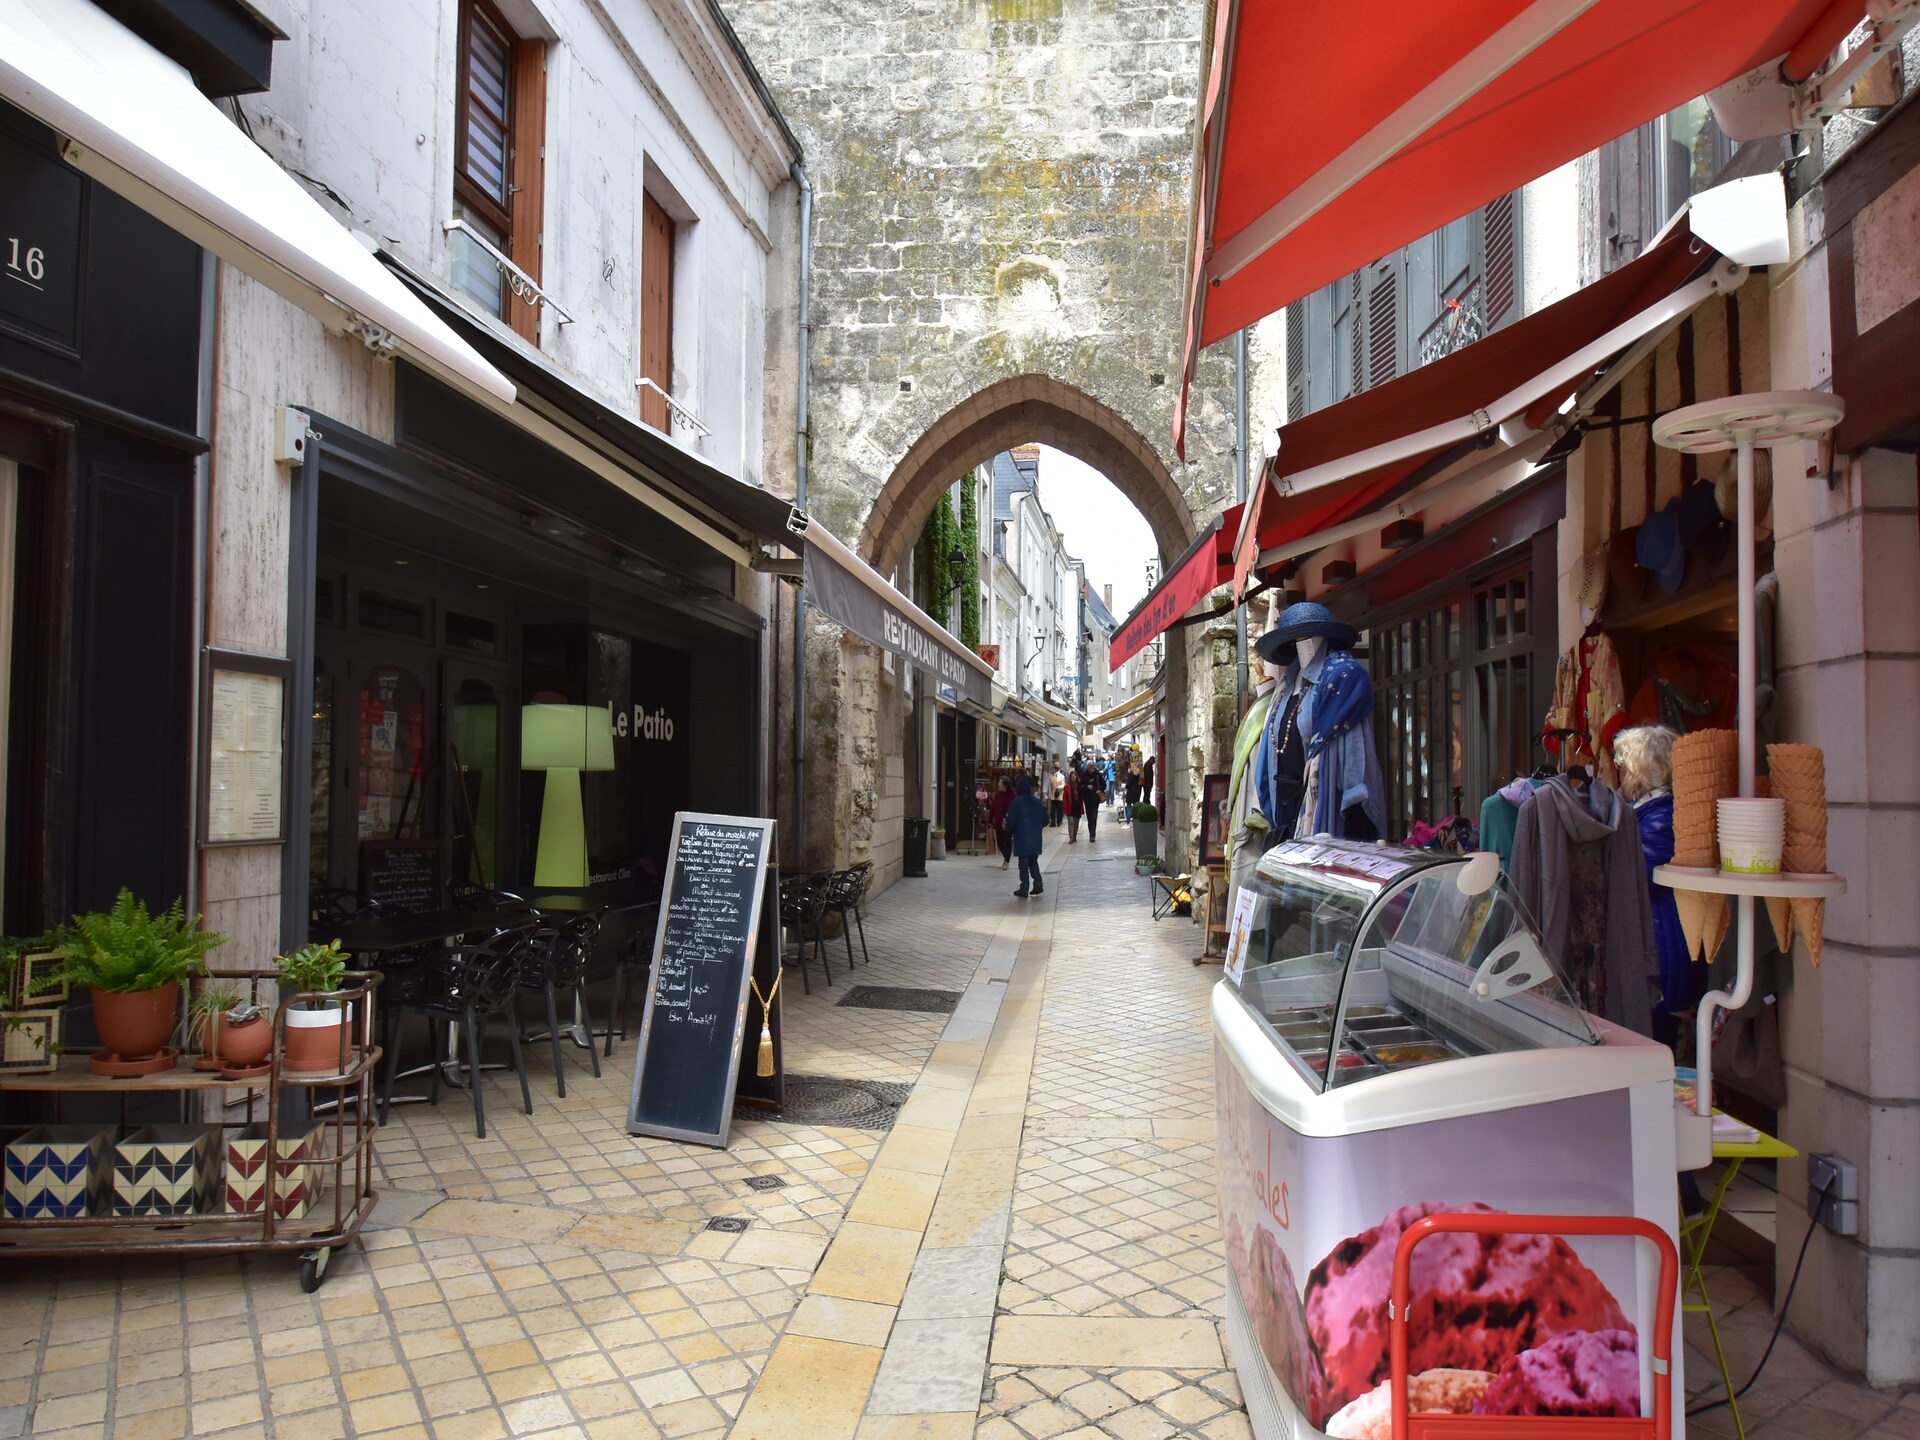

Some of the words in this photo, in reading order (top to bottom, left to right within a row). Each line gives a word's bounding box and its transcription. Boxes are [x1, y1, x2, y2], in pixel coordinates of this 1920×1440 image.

[7, 237, 44, 280] 16
[608, 700, 628, 737] Le
[634, 704, 674, 741] Patio
